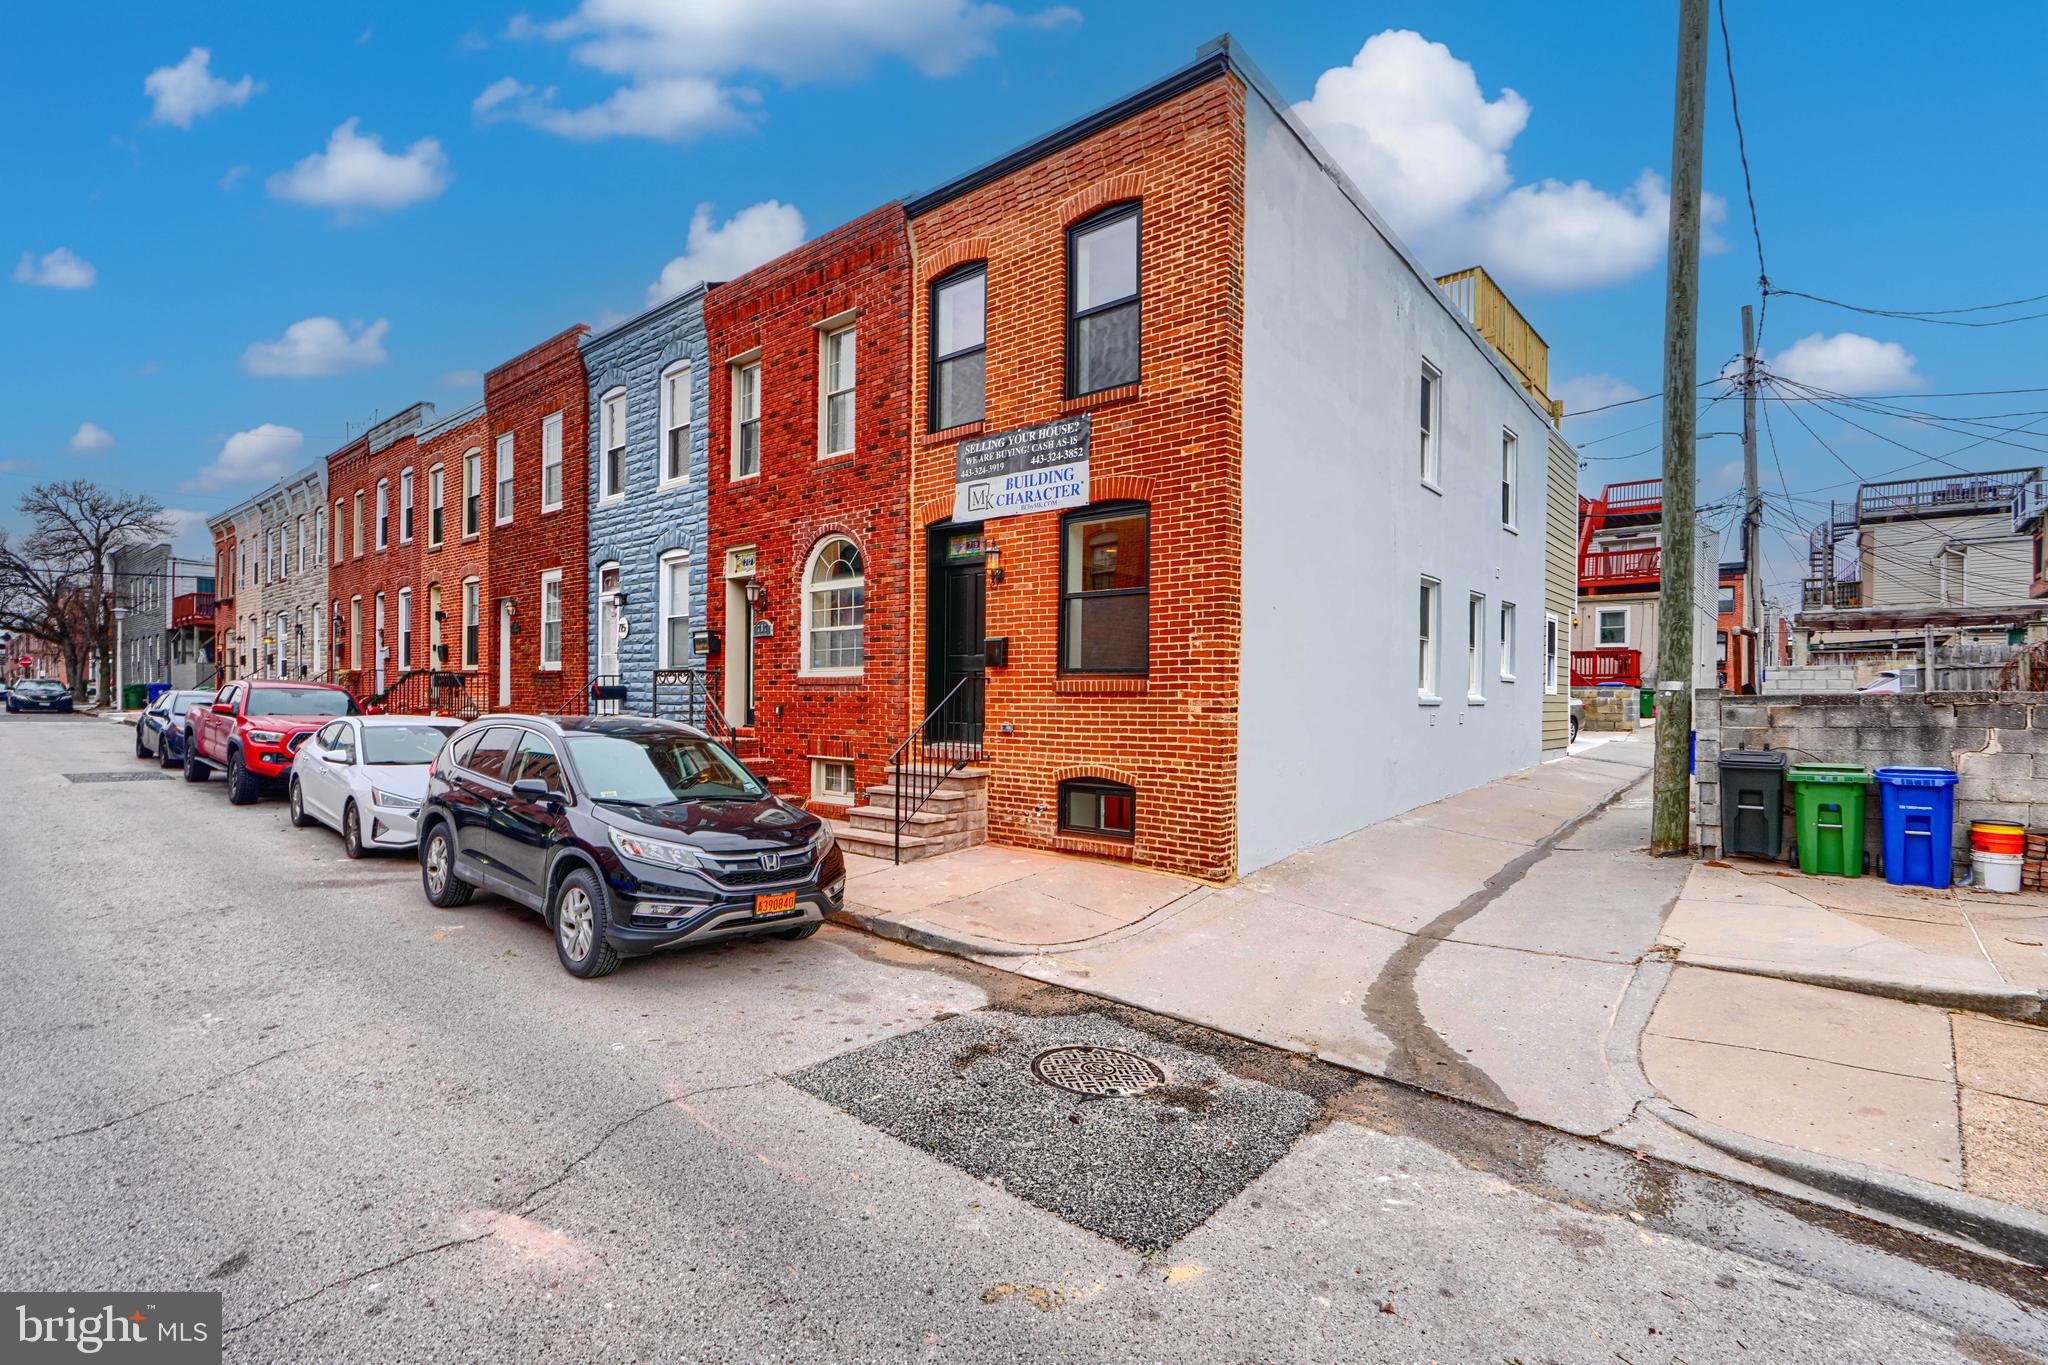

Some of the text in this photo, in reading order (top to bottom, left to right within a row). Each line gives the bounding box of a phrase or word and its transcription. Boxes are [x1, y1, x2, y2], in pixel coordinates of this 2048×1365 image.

[964, 421, 1080, 455] SELLING YOUR HOUSE?
[965, 435, 1078, 465] WE ARE BUYING! CASH AS-IS
[960, 447, 1084, 478] 443-324-3919 443-324-3852
[1005, 467, 1074, 491] BUILDING
[996, 483, 1081, 507] CHARACTER
